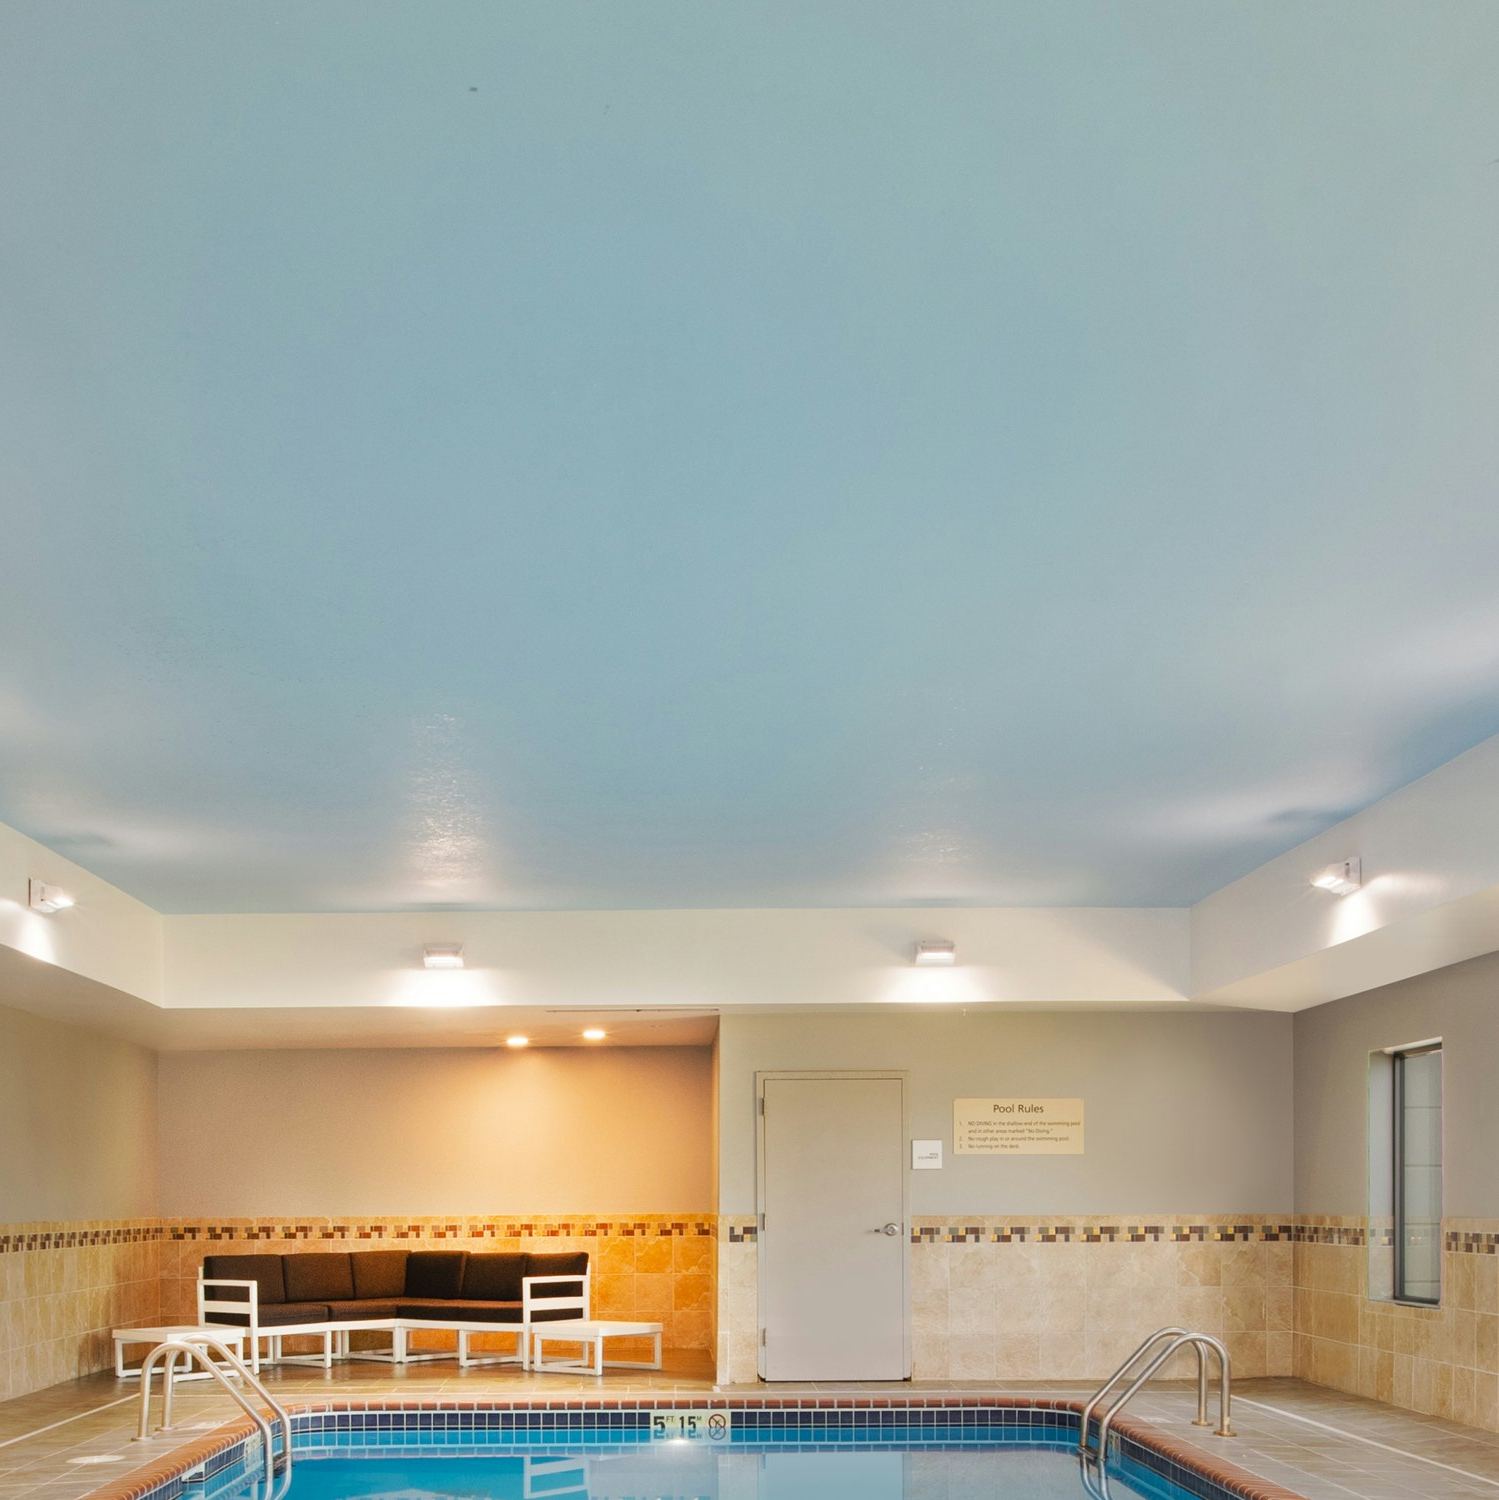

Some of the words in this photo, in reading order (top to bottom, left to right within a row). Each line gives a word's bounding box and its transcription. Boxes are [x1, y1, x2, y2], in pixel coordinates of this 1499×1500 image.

[993, 1104, 1015, 1113] Pool
[1018, 1104, 1044, 1113] Rules
[653, 1416, 665, 1428] 5
